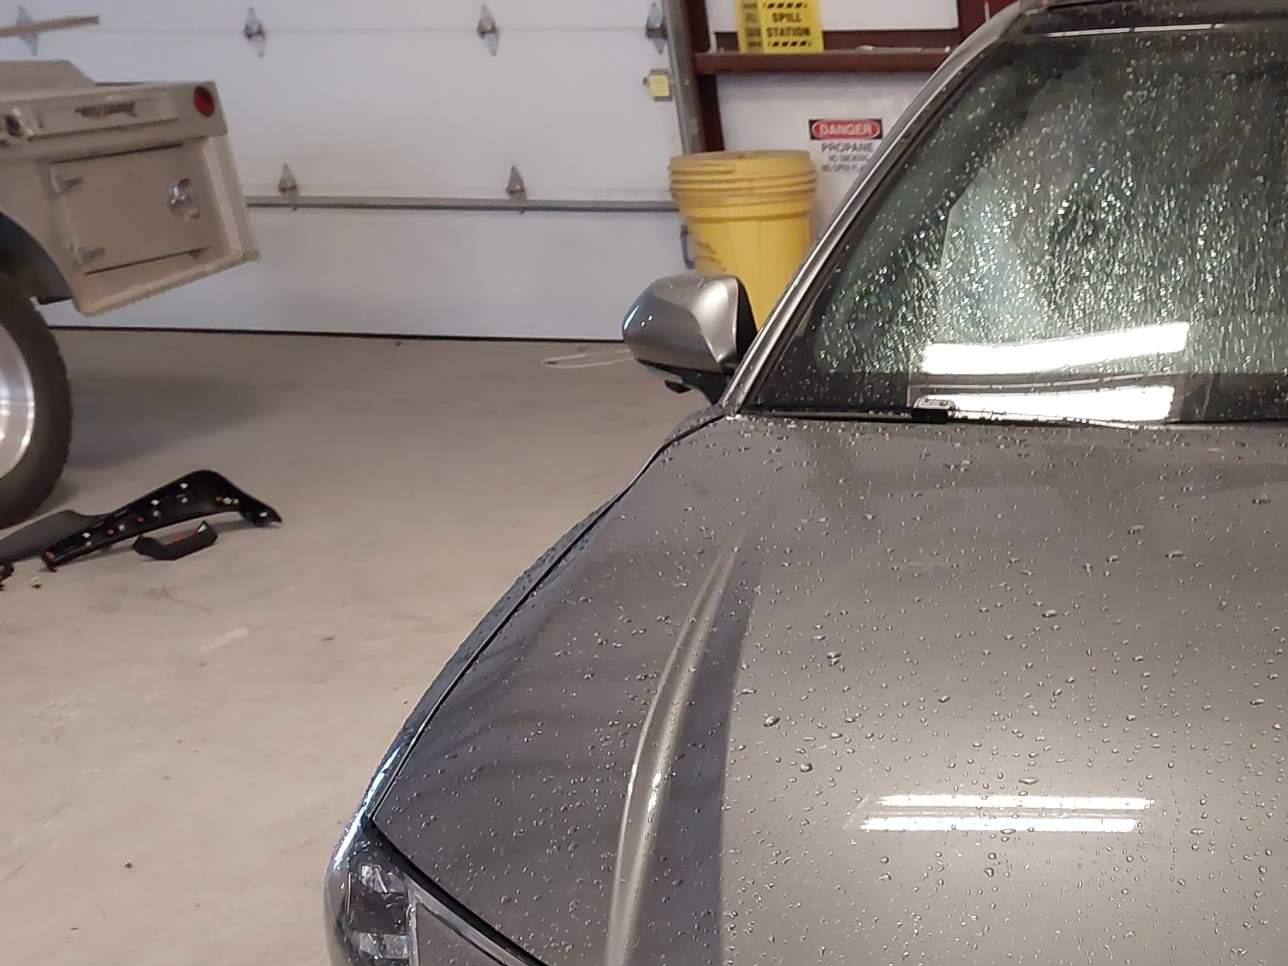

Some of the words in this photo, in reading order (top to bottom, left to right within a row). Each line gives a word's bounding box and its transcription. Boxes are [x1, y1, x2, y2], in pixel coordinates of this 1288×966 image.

[772, 13, 802, 23] SPILL
[766, 27, 811, 37] STATION
[819, 123, 873, 136] DANGER
[821, 142, 874, 153] PROPANE
